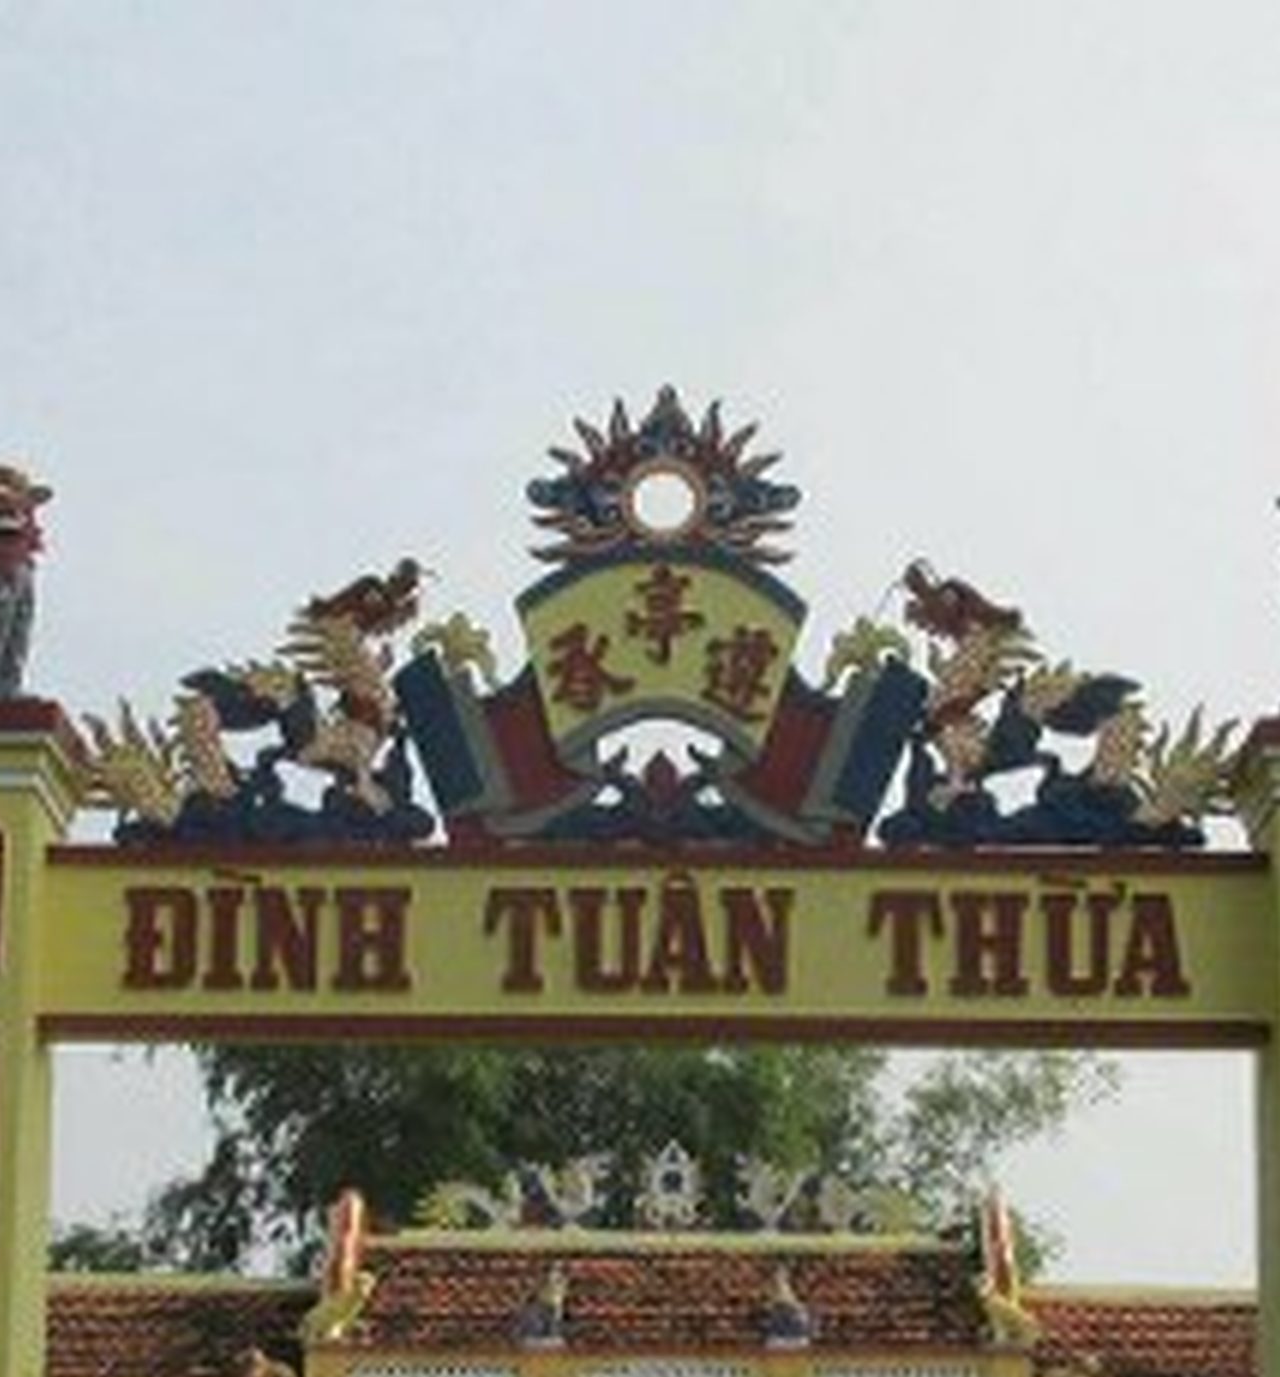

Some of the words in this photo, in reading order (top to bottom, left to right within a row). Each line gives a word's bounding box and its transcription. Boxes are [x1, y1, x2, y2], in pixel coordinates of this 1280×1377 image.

[123, 867, 413, 991] ĐÌNH
[483, 864, 795, 996] TUÂN
[867, 872, 1191, 997] THỪA
